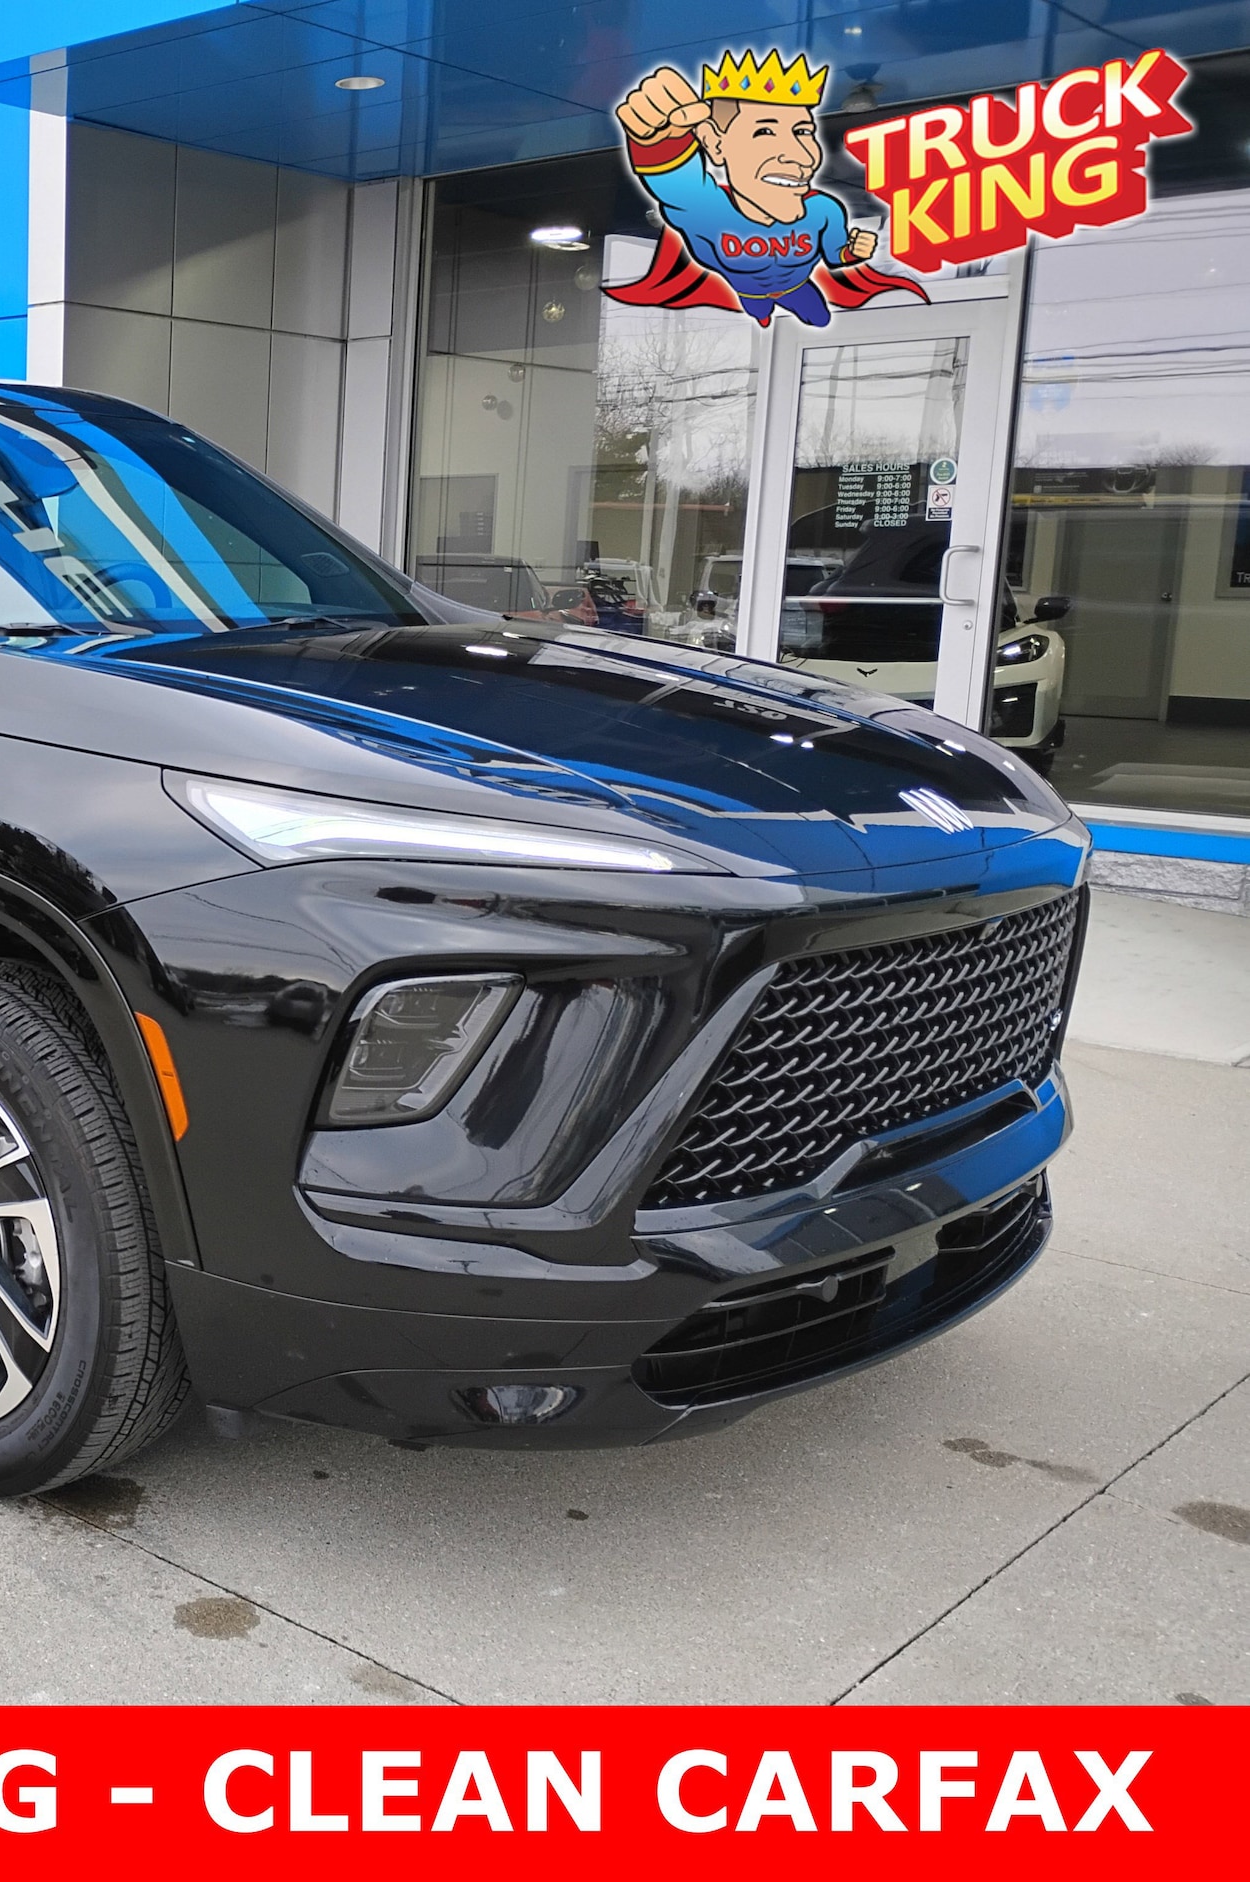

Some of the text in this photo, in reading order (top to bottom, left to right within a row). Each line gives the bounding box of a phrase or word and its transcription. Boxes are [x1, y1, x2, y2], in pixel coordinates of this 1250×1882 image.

[842, 462, 910, 473] SALES HOURS
[838, 475, 865, 483] Monday
[838, 483, 865, 491] Tuesday
[835, 506, 857, 514] Friday
[834, 520, 907, 529] Sunday CLOSED
